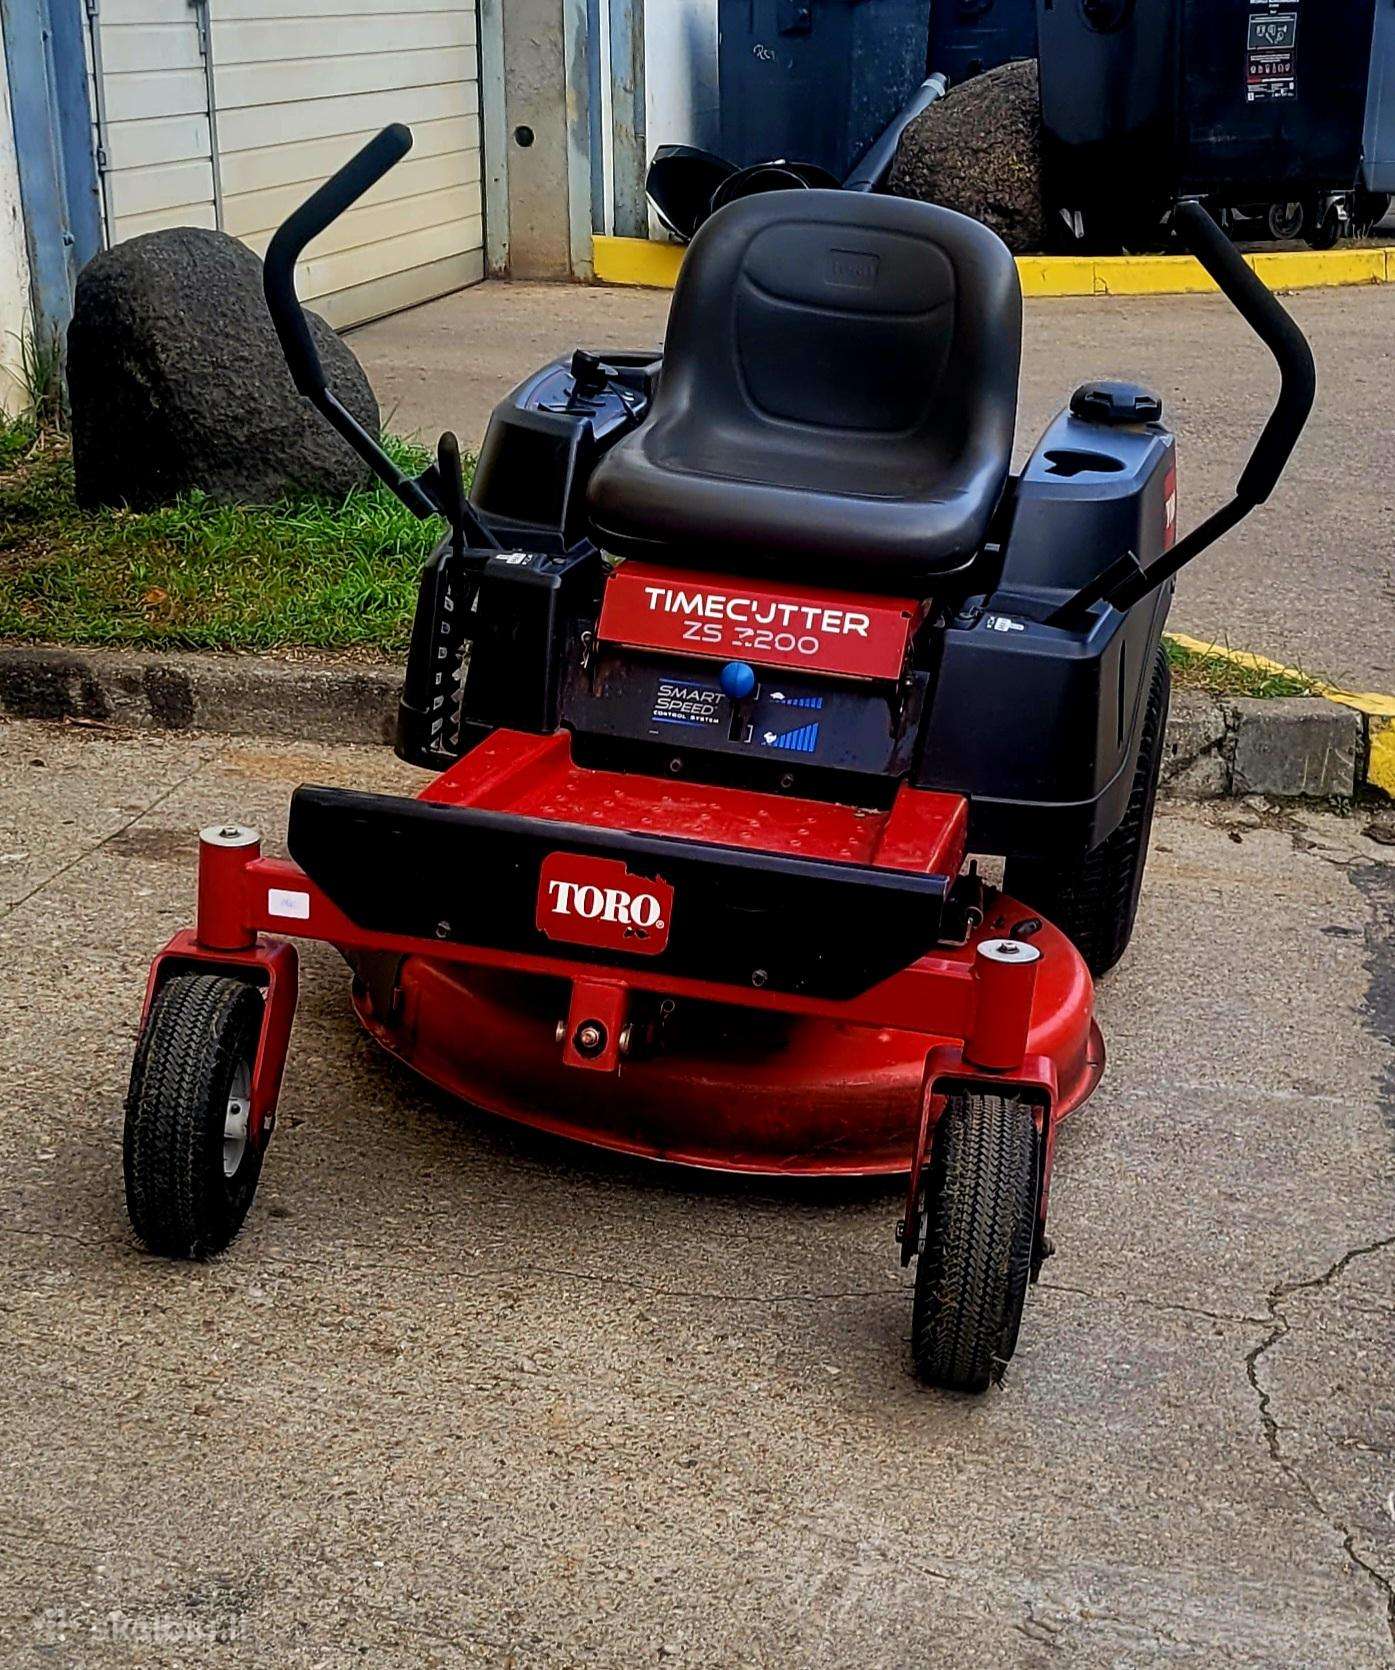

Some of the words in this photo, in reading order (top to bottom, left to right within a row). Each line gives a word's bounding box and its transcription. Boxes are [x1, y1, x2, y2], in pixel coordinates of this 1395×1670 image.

[645, 587, 870, 637] TIMECUTTER
[682, 620, 723, 643] ZS
[657, 685, 726, 704] SMART
[653, 710, 686, 719] CONTROL
[654, 698, 714, 715] SPEED
[548, 880, 661, 927] TORO
